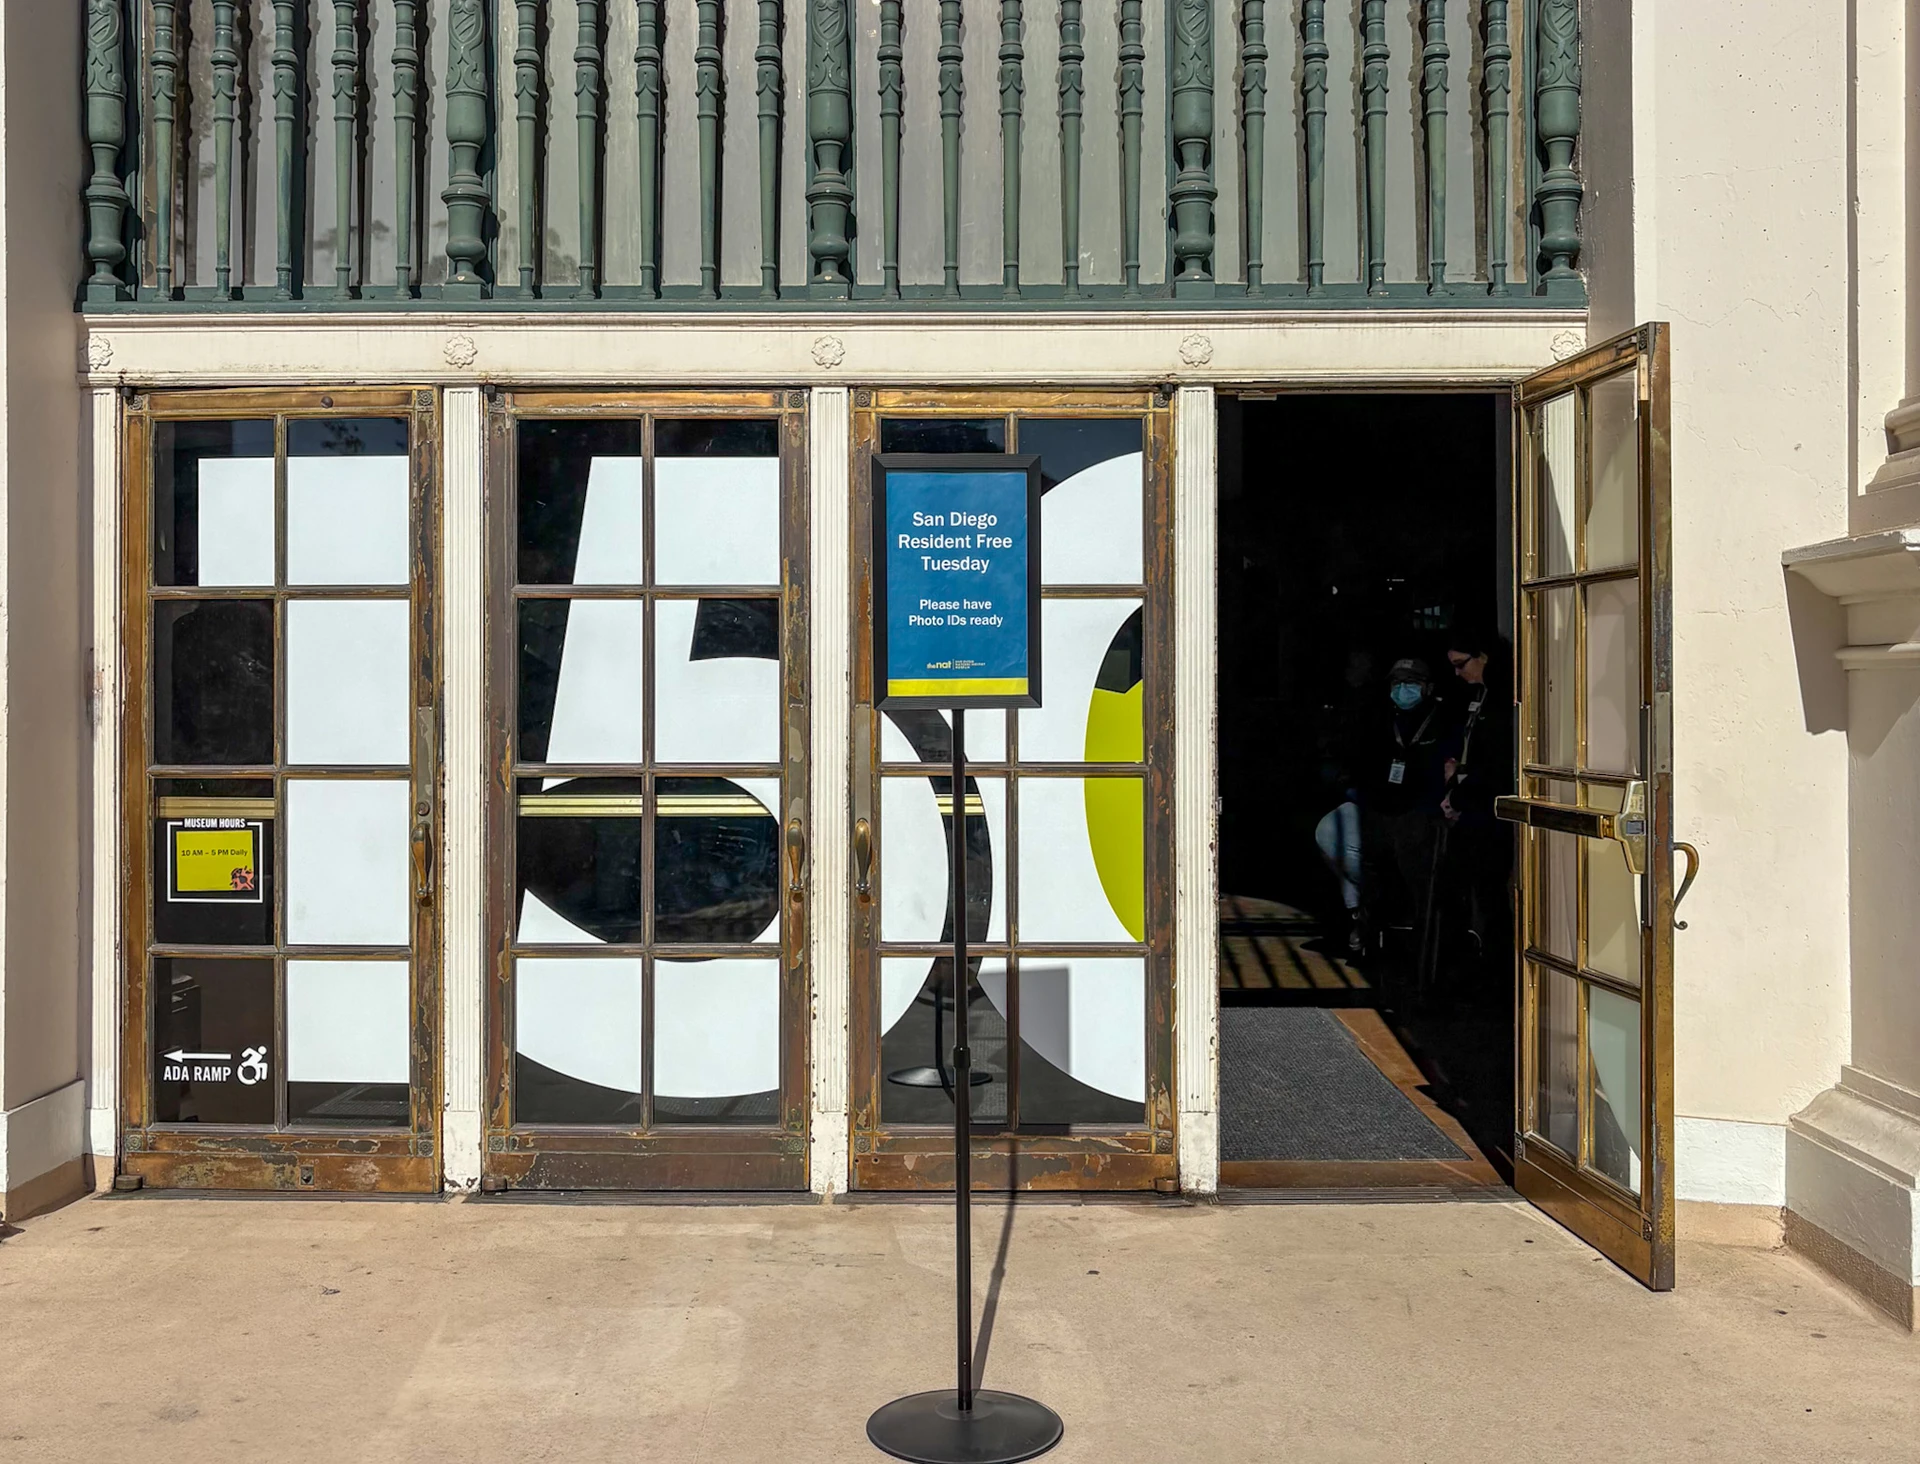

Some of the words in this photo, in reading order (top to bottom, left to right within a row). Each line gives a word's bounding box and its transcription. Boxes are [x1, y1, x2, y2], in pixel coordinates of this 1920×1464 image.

[912, 511, 945, 527] San
[950, 511, 998, 530] Diego
[898, 533, 972, 549] Resident
[976, 533, 1013, 549] Free
[920, 555, 990, 574] Tuesday
[919, 598, 960, 611] Please
[963, 598, 992, 610] have
[908, 614, 945, 626] Photo
[947, 614, 967, 626] IDs
[969, 614, 1004, 628] ready
[184, 818, 218, 828] MUSEUM
[219, 818, 246, 829] HOURS
[181, 849, 191, 857] 10
[230, 849, 248, 857] Daily
[163, 1065, 190, 1081] ADA
[193, 1066, 232, 1082] RAMP
